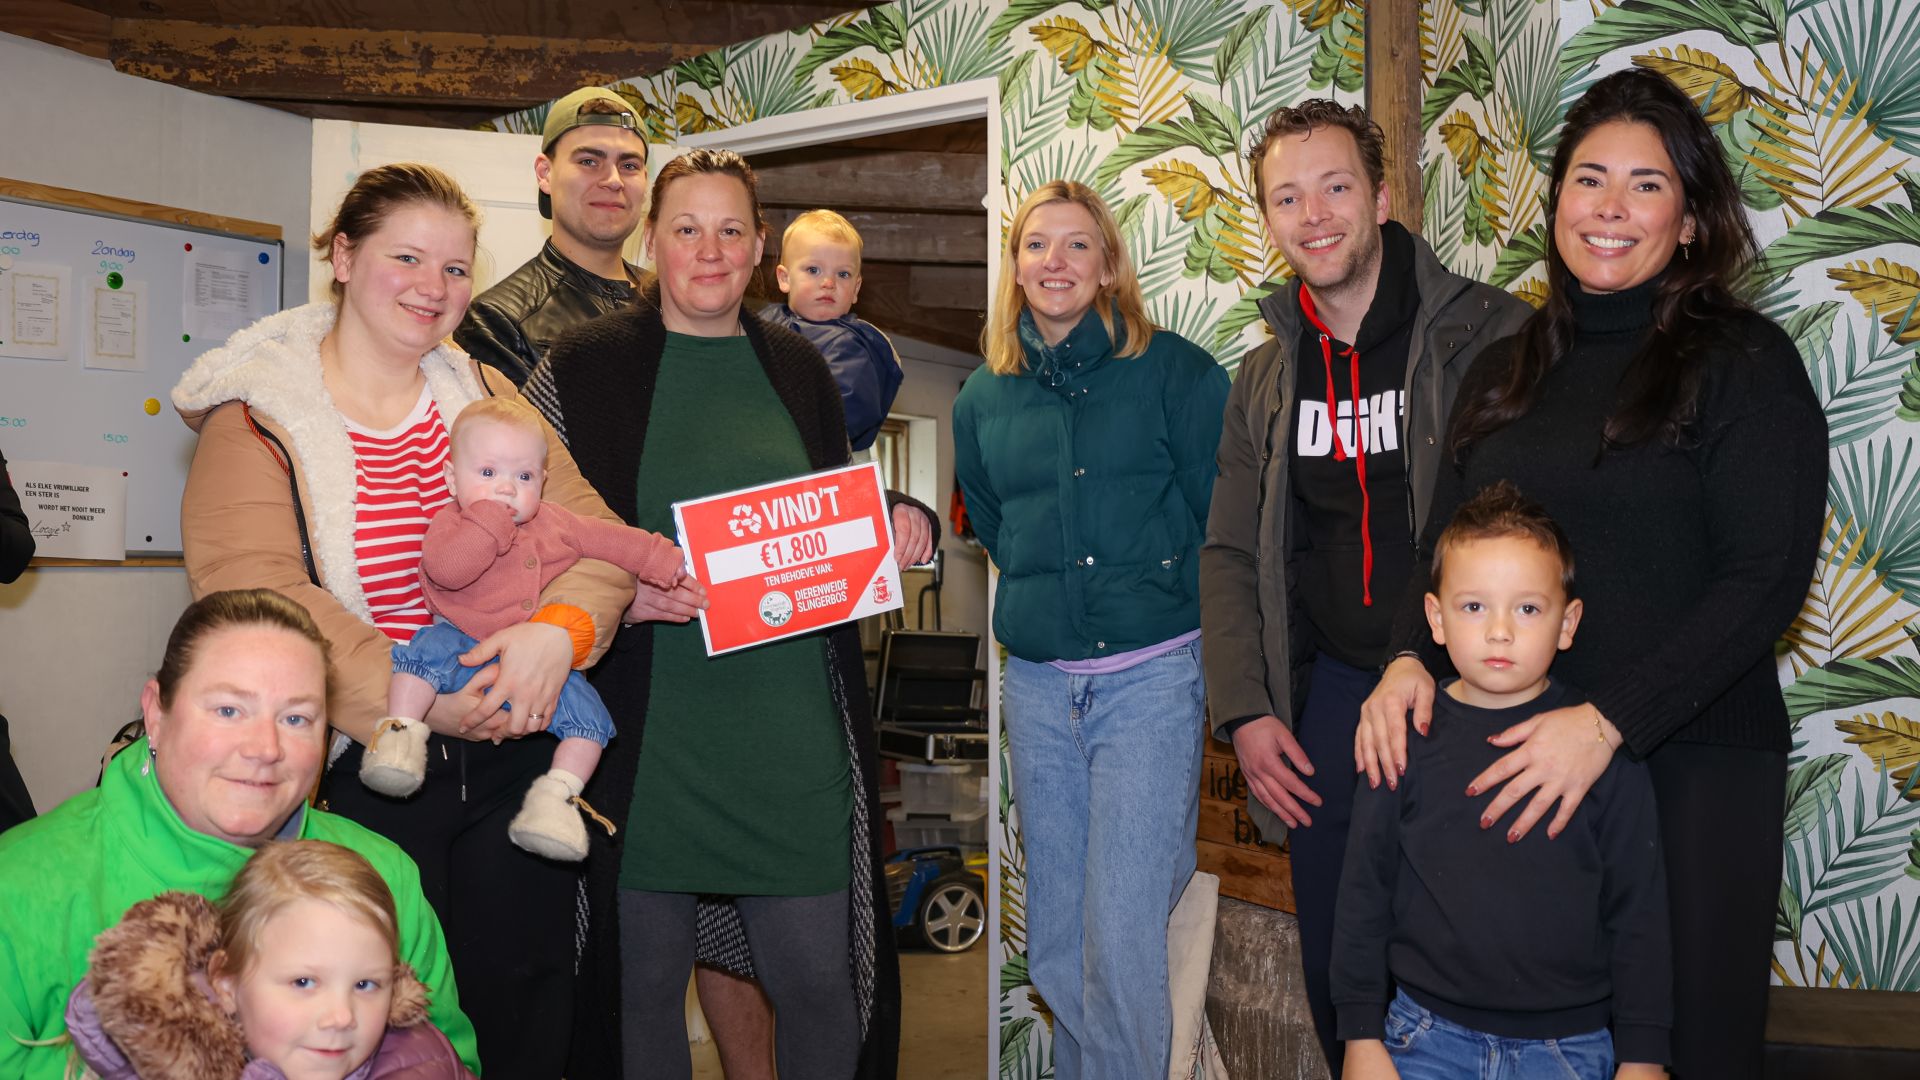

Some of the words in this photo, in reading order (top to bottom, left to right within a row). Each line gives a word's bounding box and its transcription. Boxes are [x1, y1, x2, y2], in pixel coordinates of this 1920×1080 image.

[0, 229, 40, 247] erdag
[760, 485, 840, 531] VIND'T
[760, 531, 828, 569] €1.800
[764, 574, 780, 587] TEN
[780, 565, 815, 584] BEHOEVE
[814, 563, 833, 578] VAN:
[794, 578, 849, 602] DIERENWEIDE
[797, 591, 848, 613] SLINGERBOS
